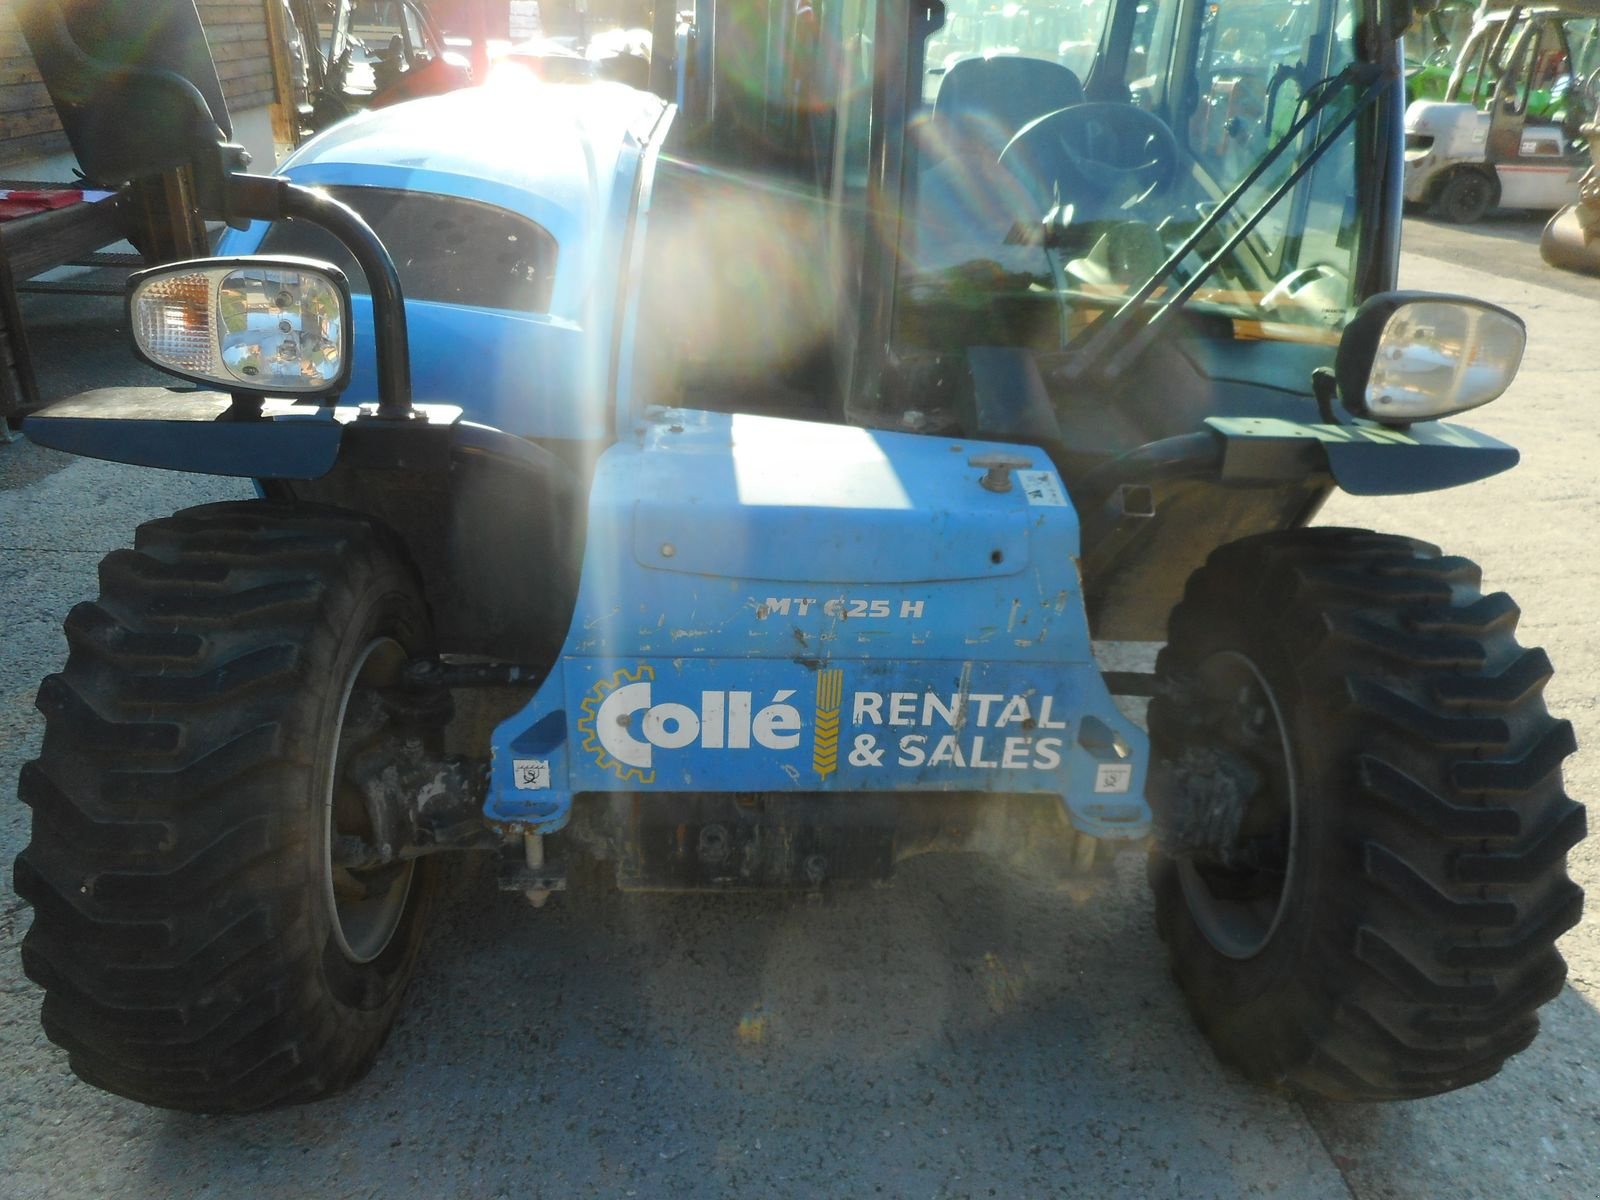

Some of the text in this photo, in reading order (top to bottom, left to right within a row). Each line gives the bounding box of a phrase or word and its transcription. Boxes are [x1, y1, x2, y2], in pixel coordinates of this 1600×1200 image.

[761, 597, 925, 619] MT 625 H
[596, 682, 801, 768] Collé
[852, 691, 1066, 729] RENTAL
[848, 733, 1063, 770] & SALES
